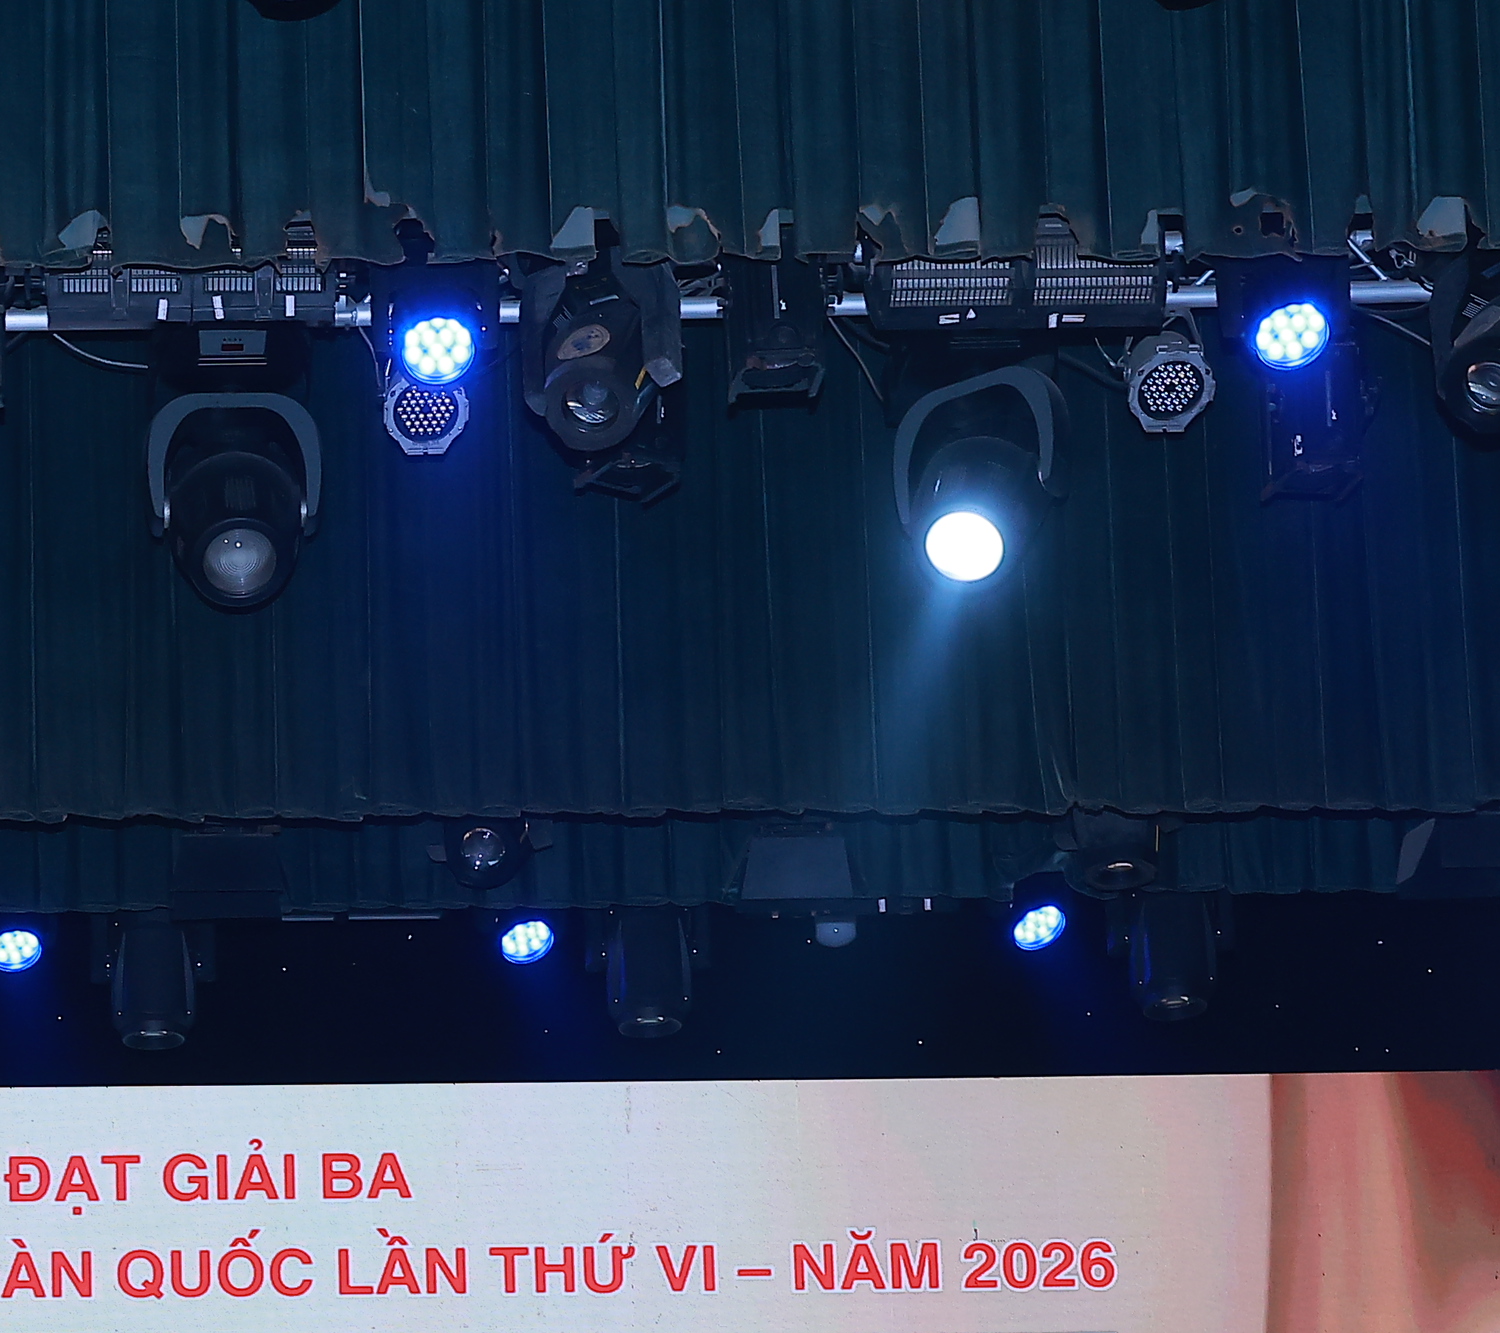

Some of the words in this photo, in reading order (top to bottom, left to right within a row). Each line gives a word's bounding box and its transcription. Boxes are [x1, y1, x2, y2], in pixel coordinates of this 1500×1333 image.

[5, 1154, 142, 1216] ĐẠT
[163, 1138, 296, 1202] GIẢI
[322, 1152, 413, 1200] BA
[117, 1228, 314, 1299] QUỐC
[339, 1227, 468, 1295] LẦN
[489, 1232, 636, 1294] THỨ
[656, 1244, 716, 1292] VI
[793, 1230, 940, 1291] NĂM
[964, 1240, 1116, 1289] 2026
